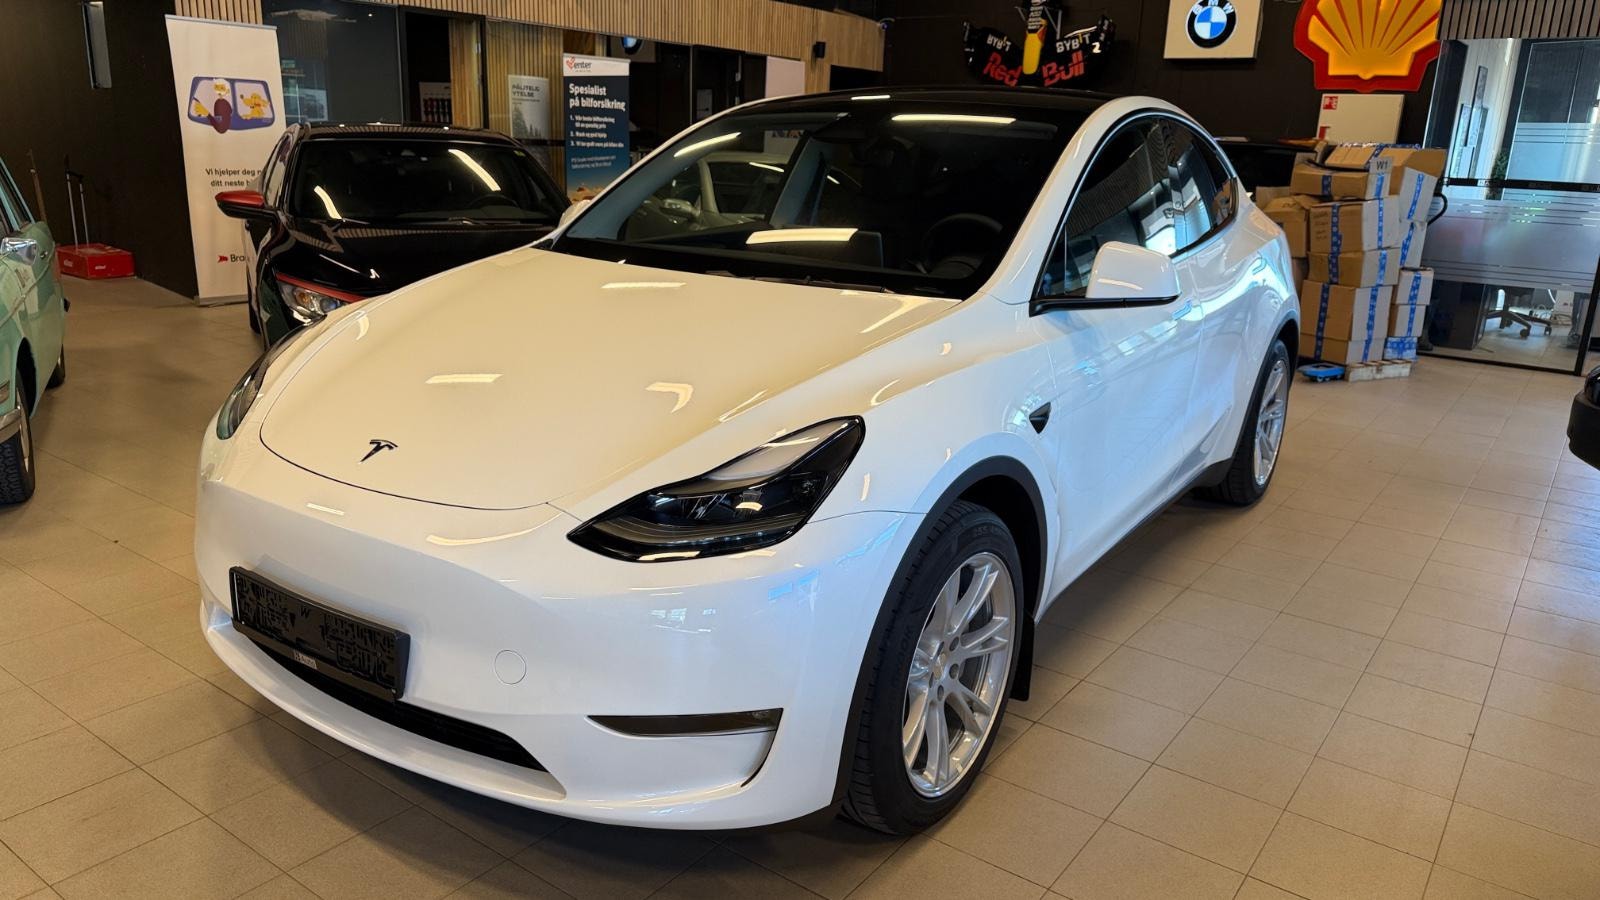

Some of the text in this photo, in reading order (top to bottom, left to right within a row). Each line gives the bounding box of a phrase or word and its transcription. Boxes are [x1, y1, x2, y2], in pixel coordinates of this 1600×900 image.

[1192, 0, 1235, 15] BMW
[1056, 32, 1091, 54] BYBIT
[983, 49, 1085, 88] Red Bull
[569, 83, 607, 96] Spesialist
[569, 96, 626, 112] på bilforsikring
[214, 168, 240, 176] hjelper
[241, 168, 256, 176] deg
[1376, 160, 1388, 170] W1
